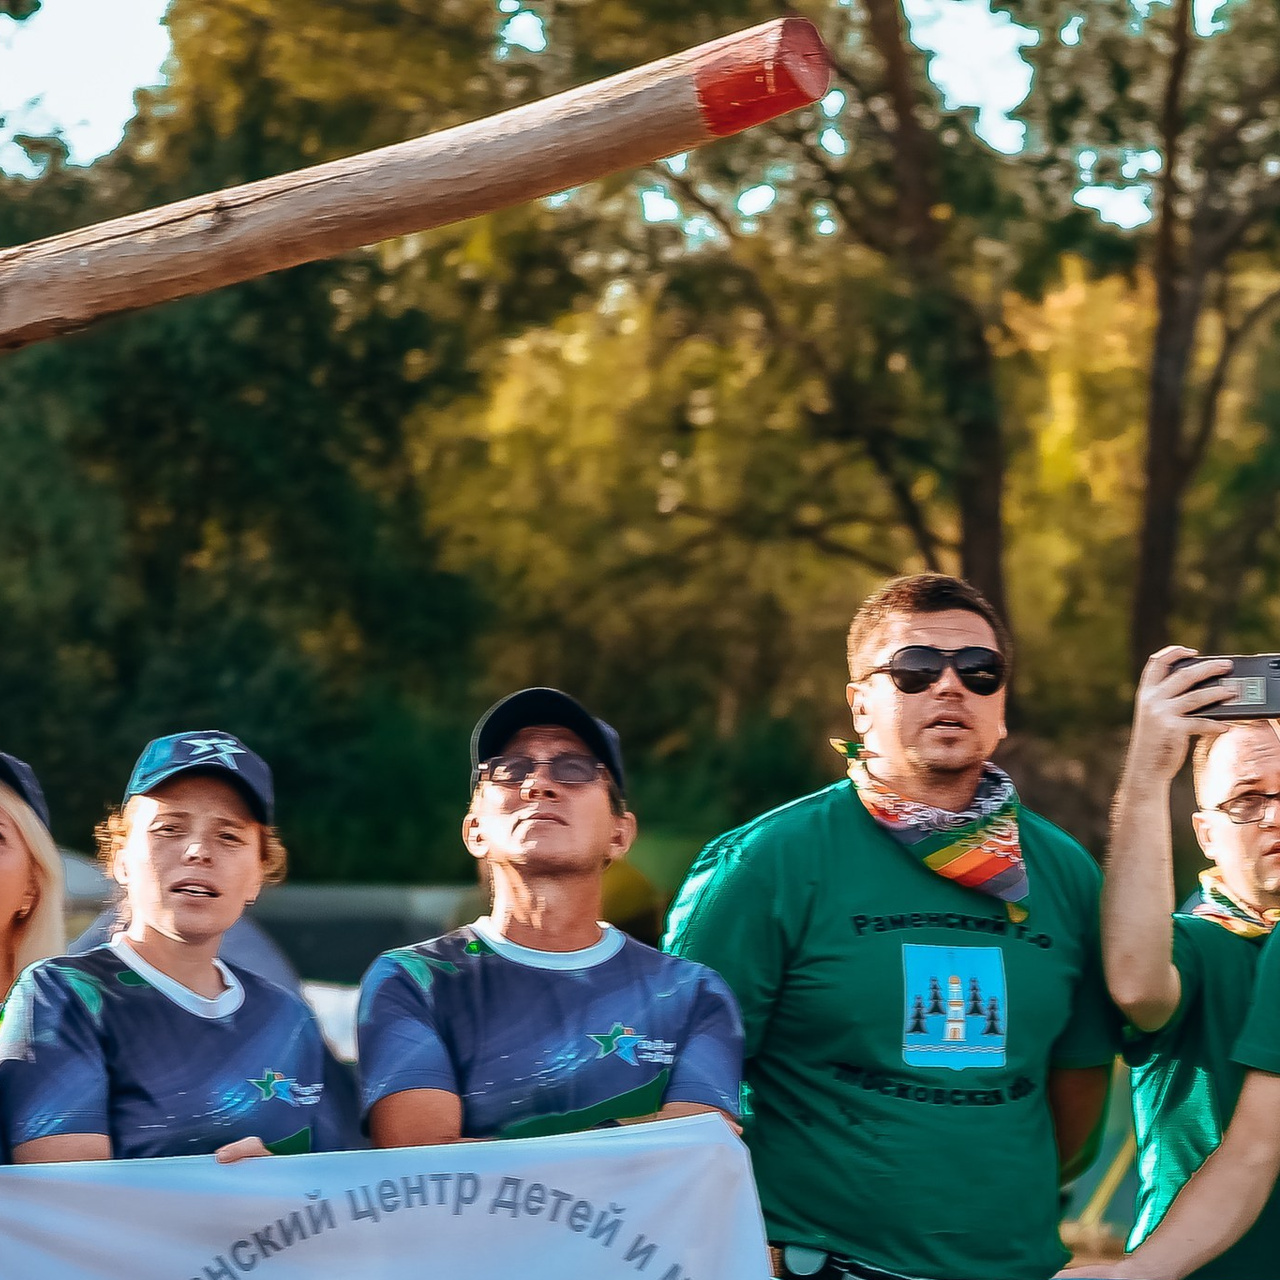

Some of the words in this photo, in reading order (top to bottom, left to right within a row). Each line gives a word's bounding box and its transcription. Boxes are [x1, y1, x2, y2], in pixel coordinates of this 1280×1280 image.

[349, 1171, 480, 1224] центр
[489, 1174, 628, 1251] детей
[625, 1232, 663, 1273] и
